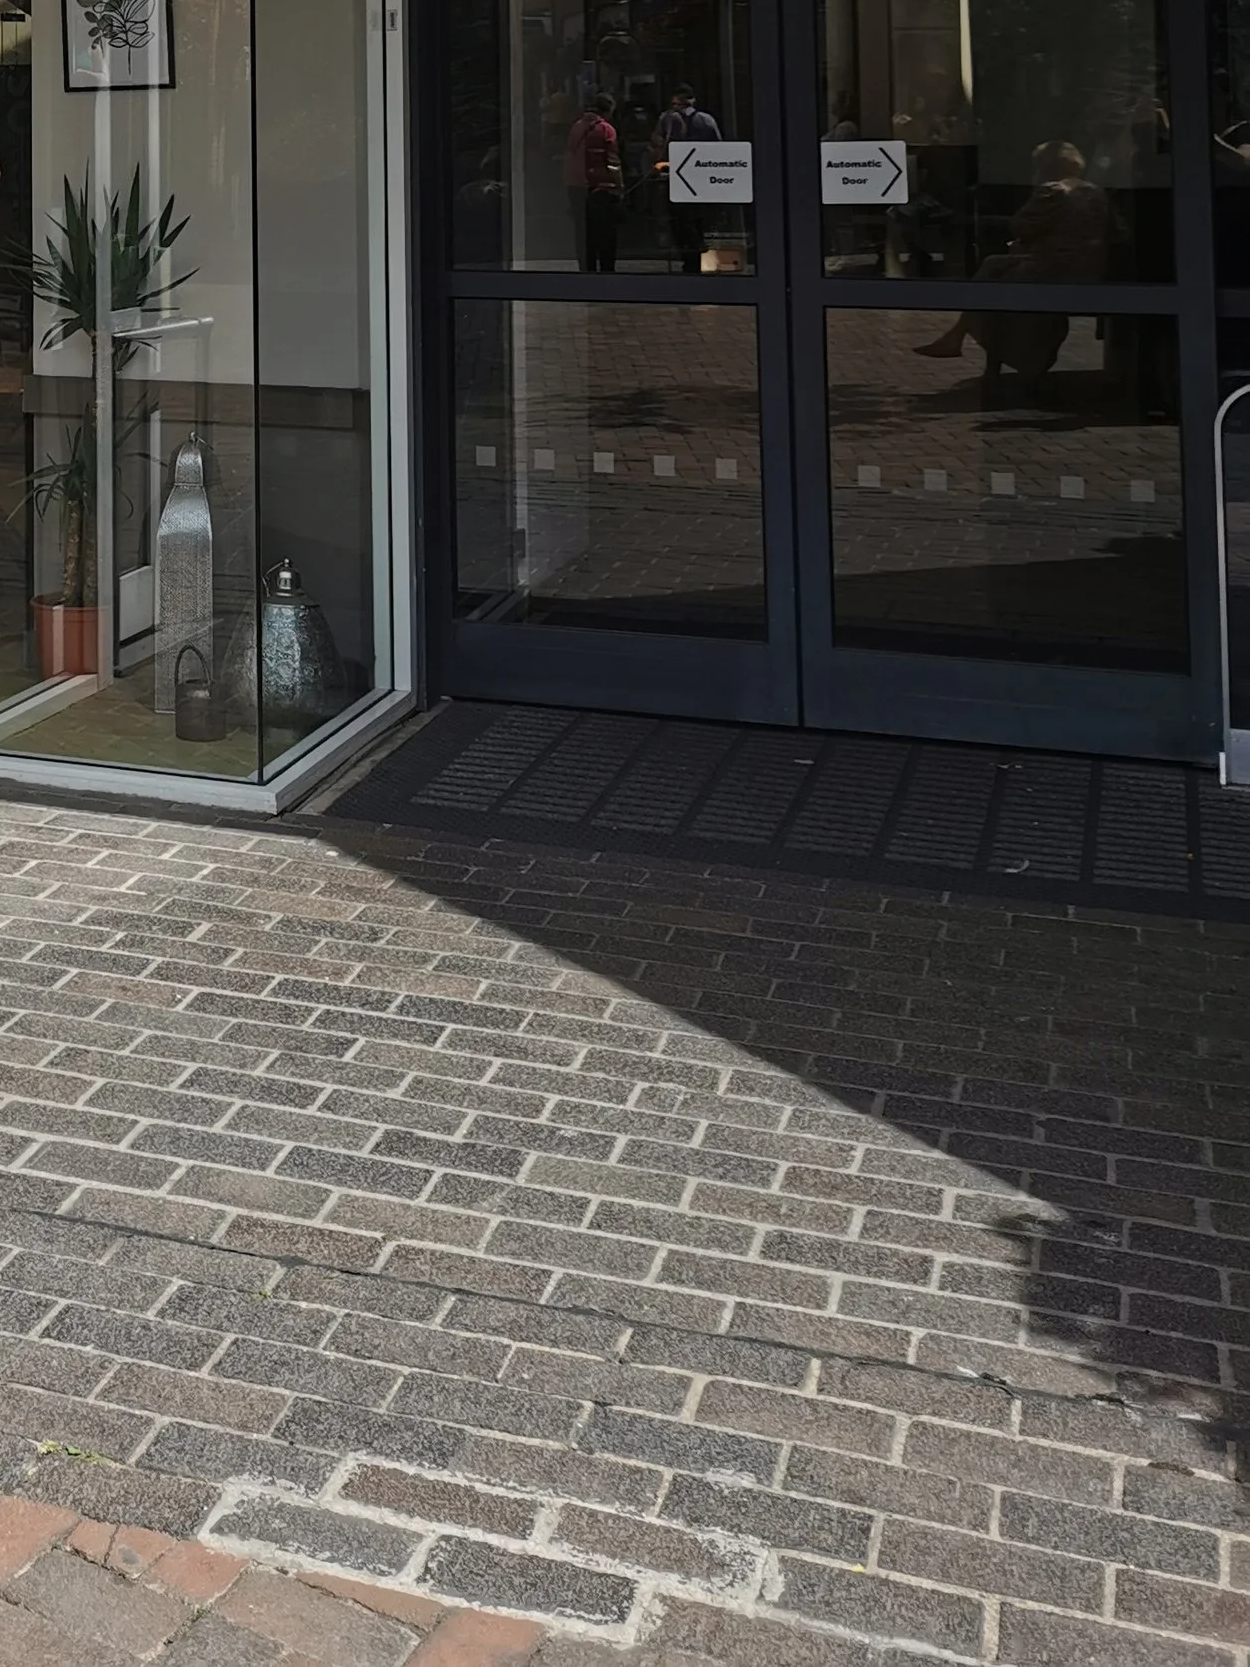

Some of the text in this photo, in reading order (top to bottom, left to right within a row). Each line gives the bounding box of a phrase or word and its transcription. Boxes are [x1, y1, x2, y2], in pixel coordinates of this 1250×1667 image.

[694, 160, 748, 168] Automatic
[826, 160, 882, 168] Automatic
[709, 176, 735, 184] Door
[841, 177, 868, 185] Door
